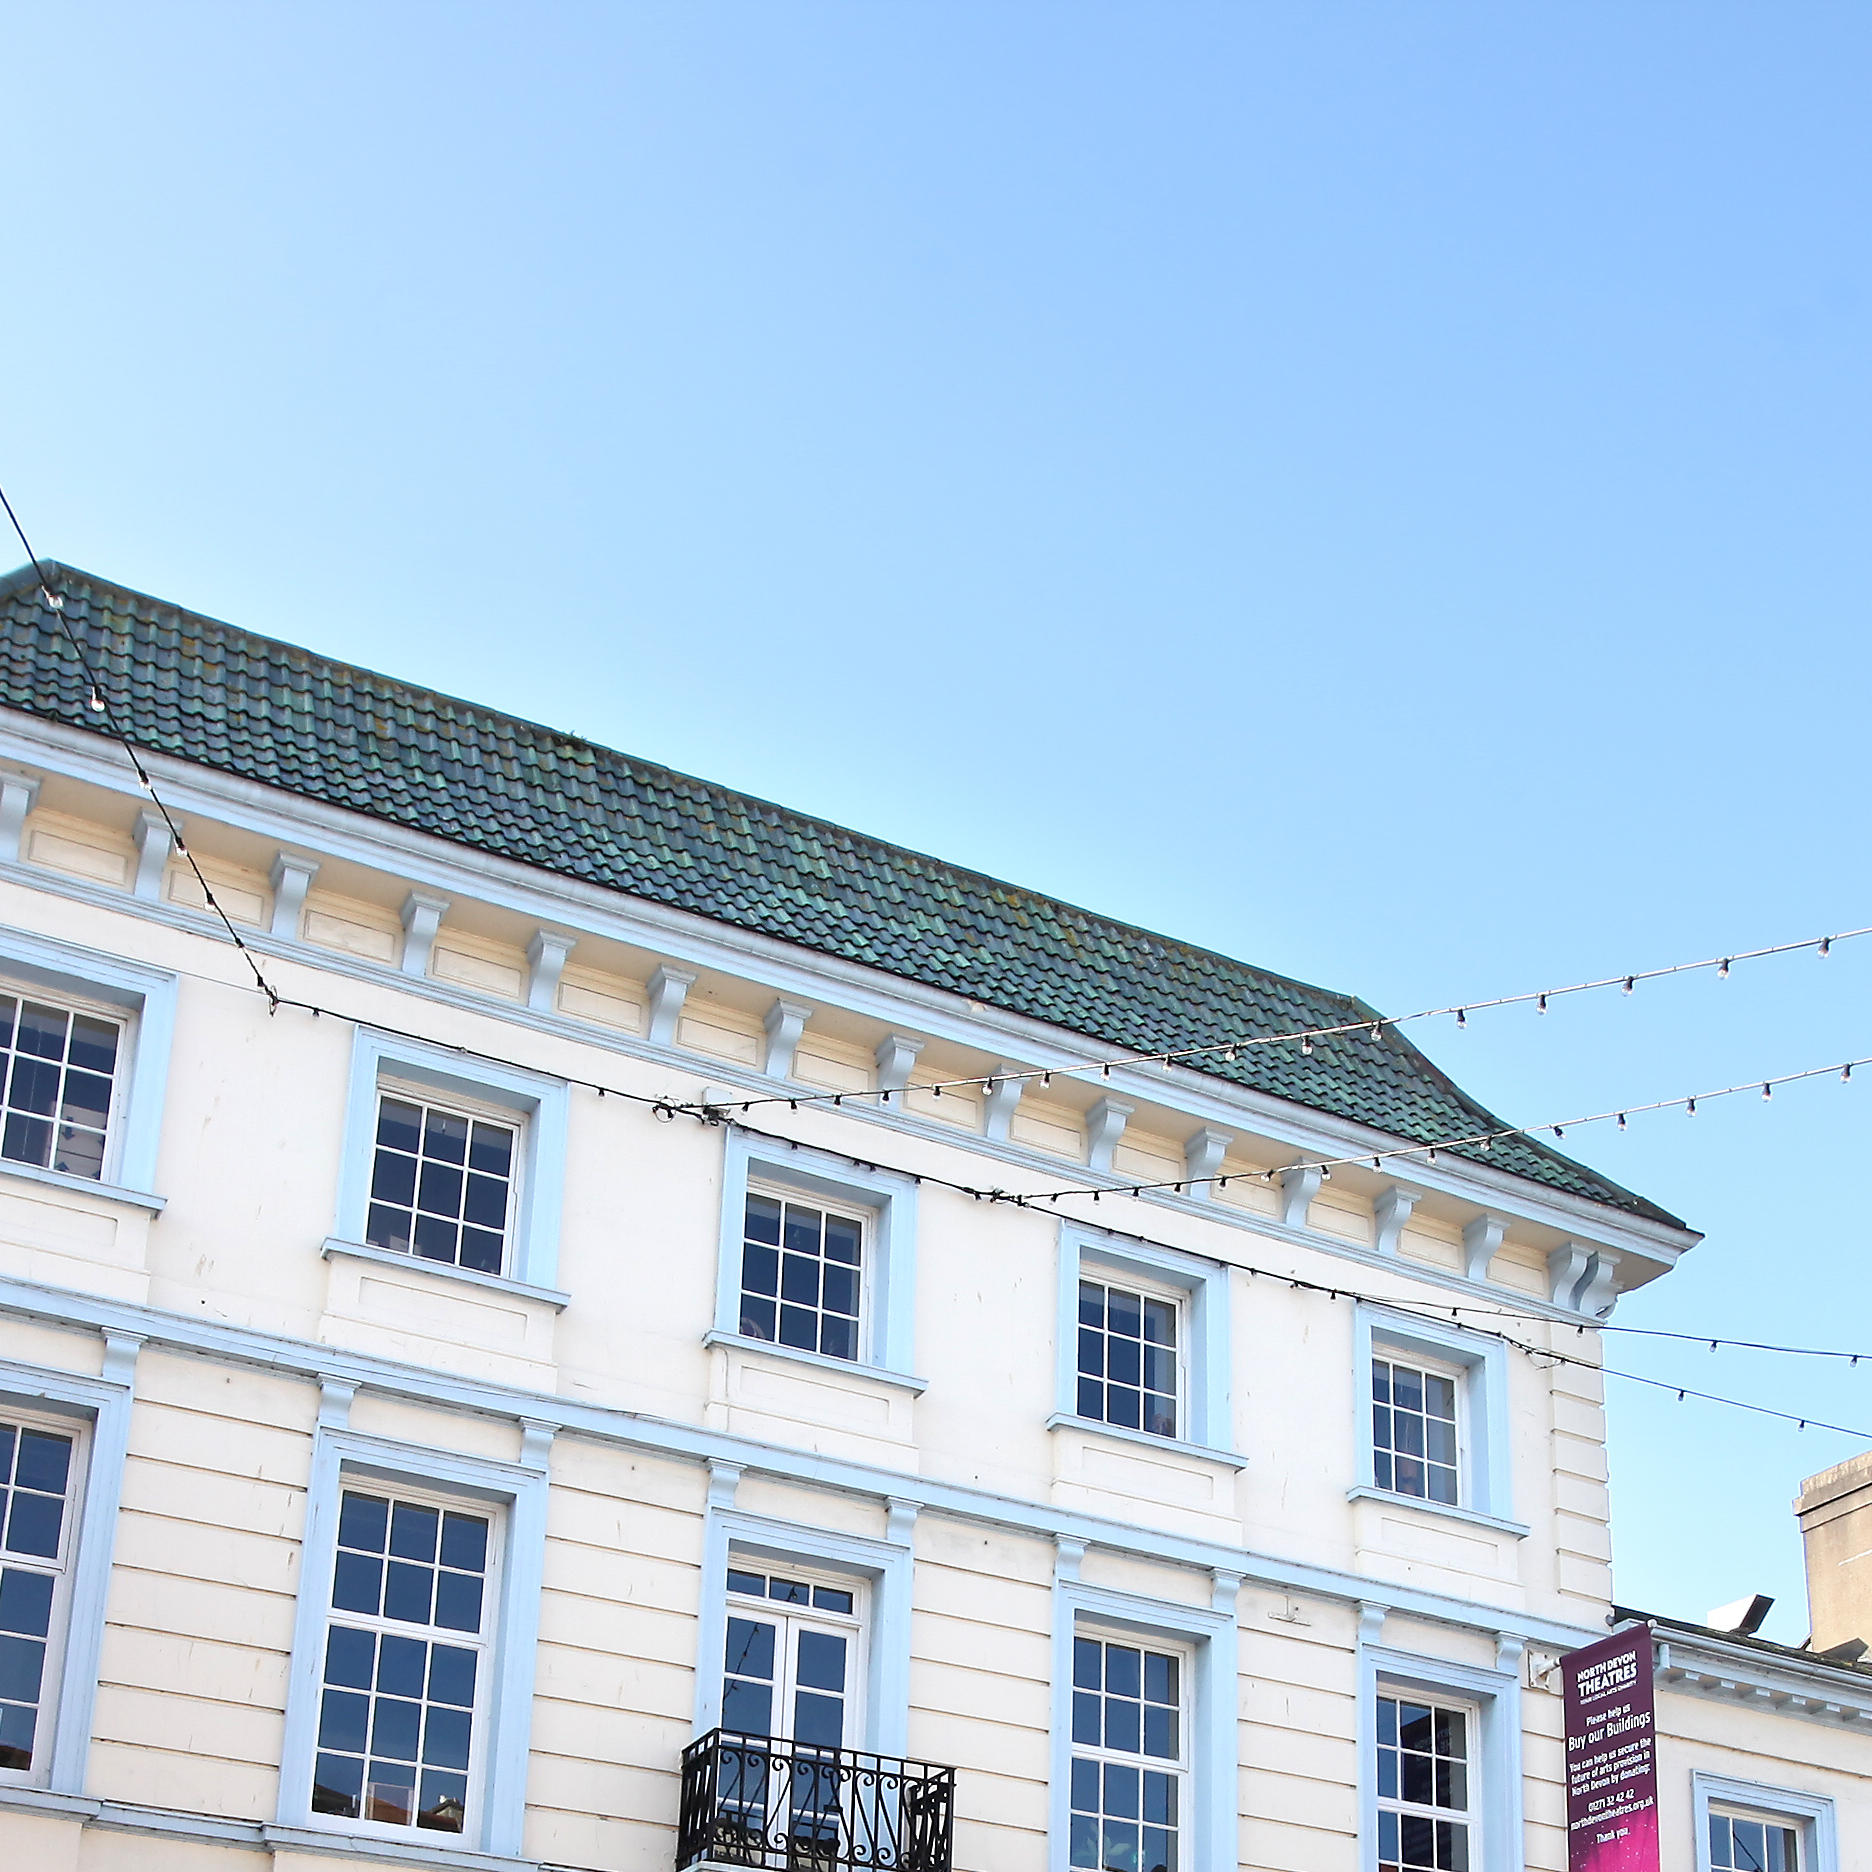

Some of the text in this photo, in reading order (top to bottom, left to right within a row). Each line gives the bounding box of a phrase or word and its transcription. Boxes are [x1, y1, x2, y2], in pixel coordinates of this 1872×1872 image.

[1577, 1650, 1636, 1682] NORTH DEVON
[1578, 1662, 1637, 1696] THEATRES
[1586, 1703, 1630, 1726] Please help us
[1568, 1711, 1651, 1751] Buy our Buildings
[1570, 1763, 1580, 1772] You
[1582, 1759, 1593, 1768] can
[1594, 1753, 1607, 1764] help
[1609, 1750, 1616, 1759] us
[1640, 1738, 1651, 1748] the
[1592, 1767, 1598, 1777] of
[1644, 1750, 1650, 1759] in
[1571, 1784, 1589, 1796] North
[1591, 1777, 1610, 1790] Devon
[1611, 1774, 1619, 1784] by
[1588, 1789, 1634, 1812] 01271 32 42 42
[1596, 1829, 1615, 1843] Thank
